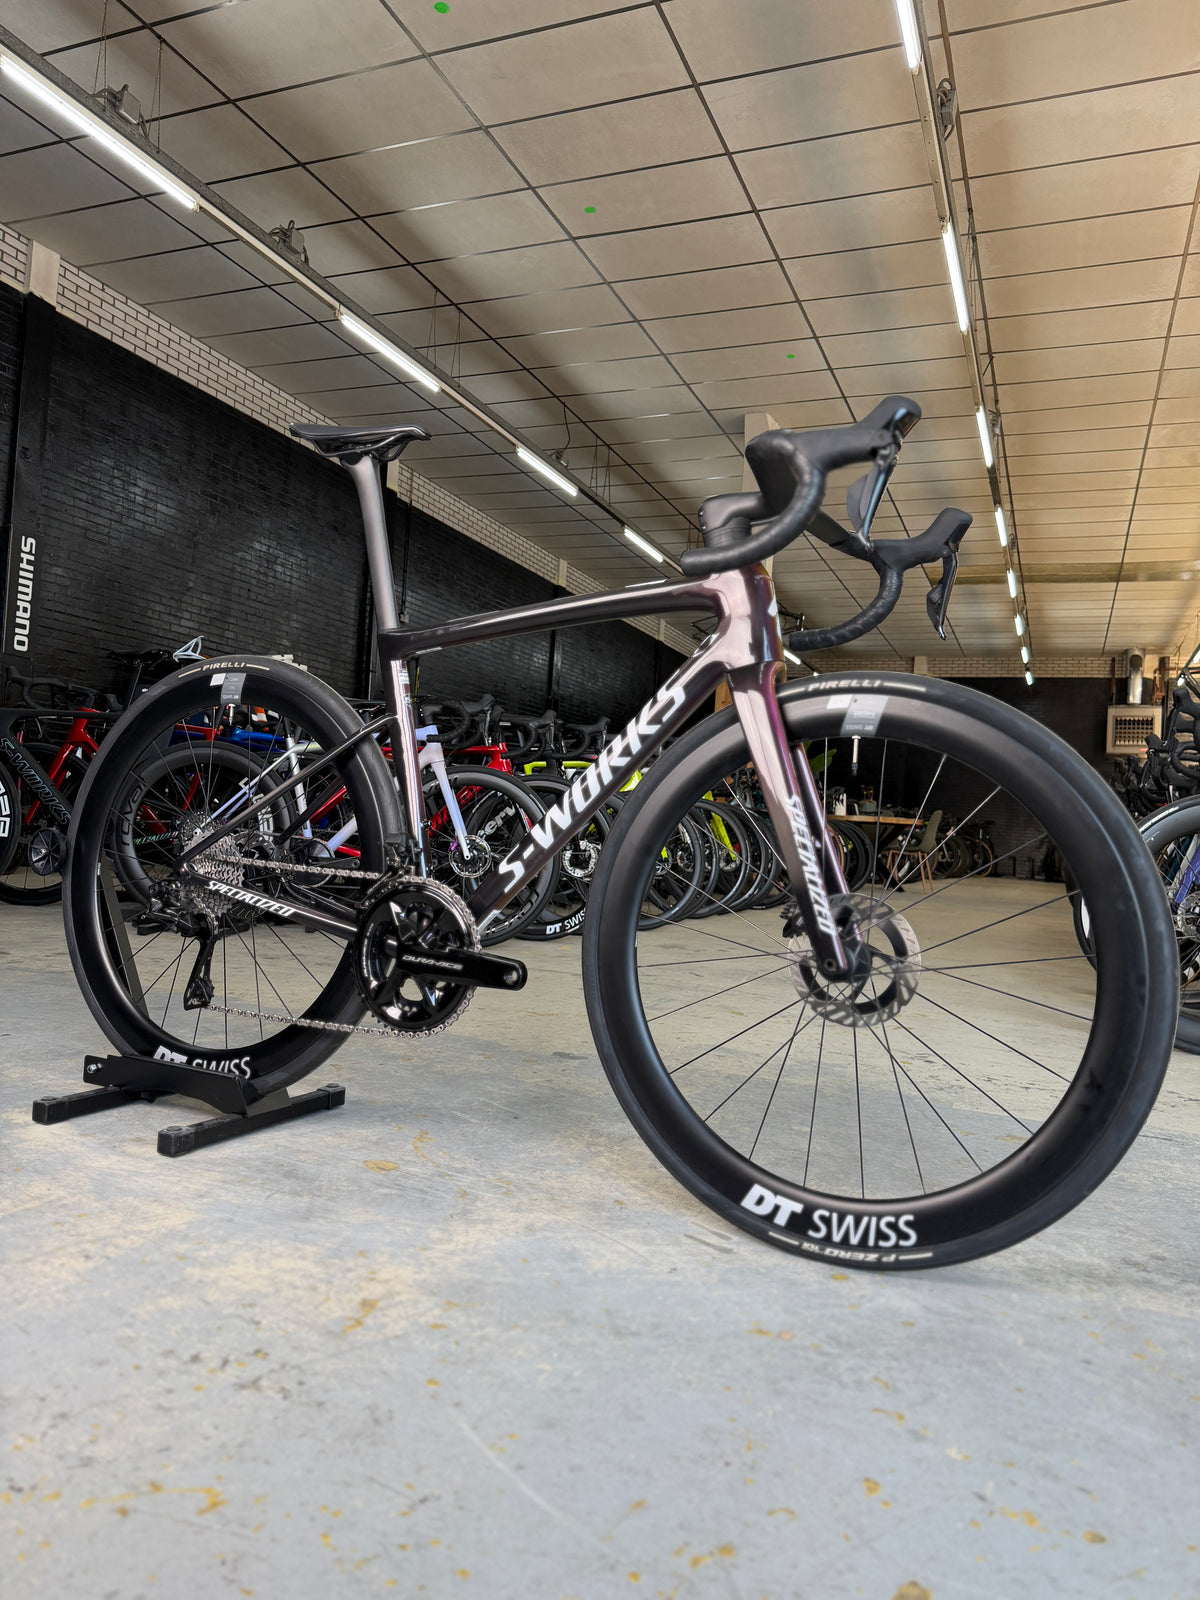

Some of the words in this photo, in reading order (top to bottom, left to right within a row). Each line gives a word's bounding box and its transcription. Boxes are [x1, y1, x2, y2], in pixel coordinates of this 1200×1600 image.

[13, 535, 37, 652] SHIMANO
[202, 661, 246, 671] PIRELLI
[807, 679, 882, 692] PIRELLI
[499, 685, 686, 893] S-WORKS
[784, 794, 837, 937] SPECIALIZED
[204, 880, 296, 917] SPECIALIZED
[545, 922, 563, 935] DT
[402, 954, 464, 970] DURA-ACE
[740, 1183, 804, 1227] DT
[807, 1208, 918, 1248] SWISS
